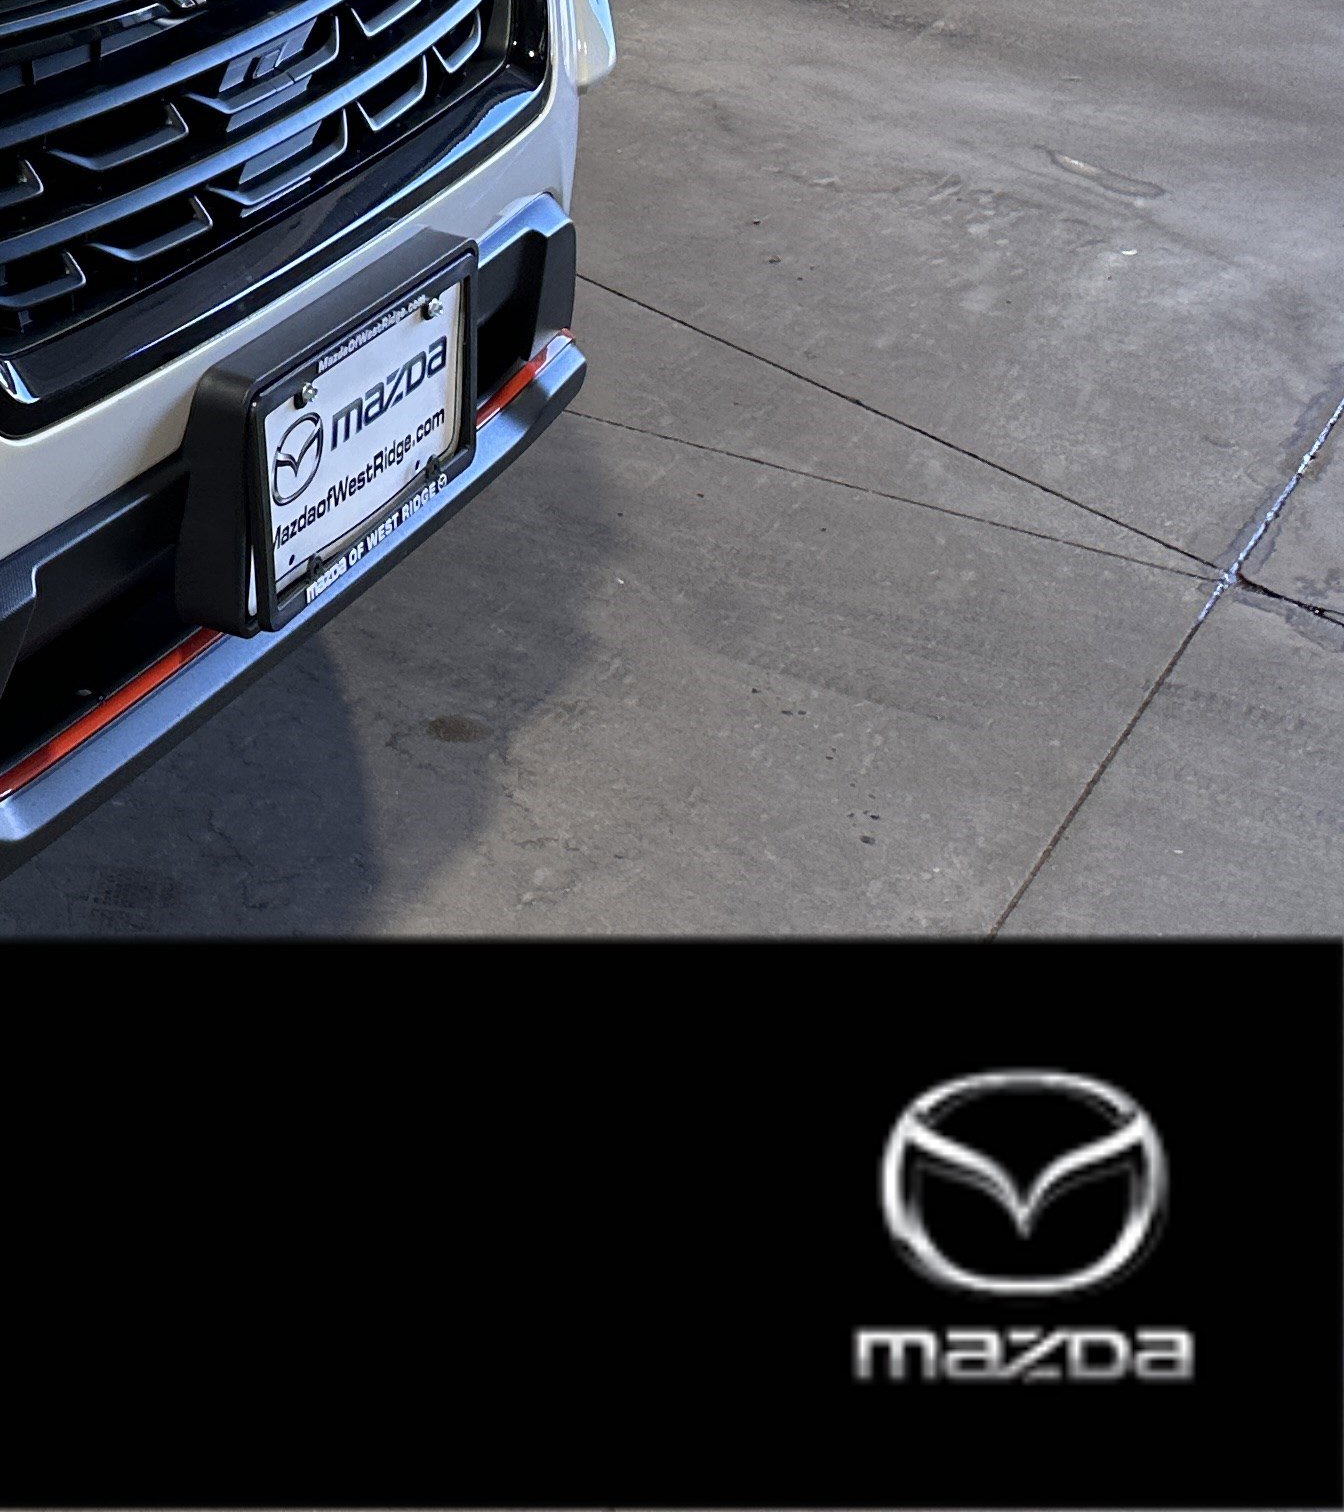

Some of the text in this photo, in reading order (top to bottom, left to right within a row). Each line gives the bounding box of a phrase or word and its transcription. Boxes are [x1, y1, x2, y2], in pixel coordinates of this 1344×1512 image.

[348, 541, 366, 567] OF
[366, 512, 401, 551] WEST
[401, 483, 438, 522] RIDGE
